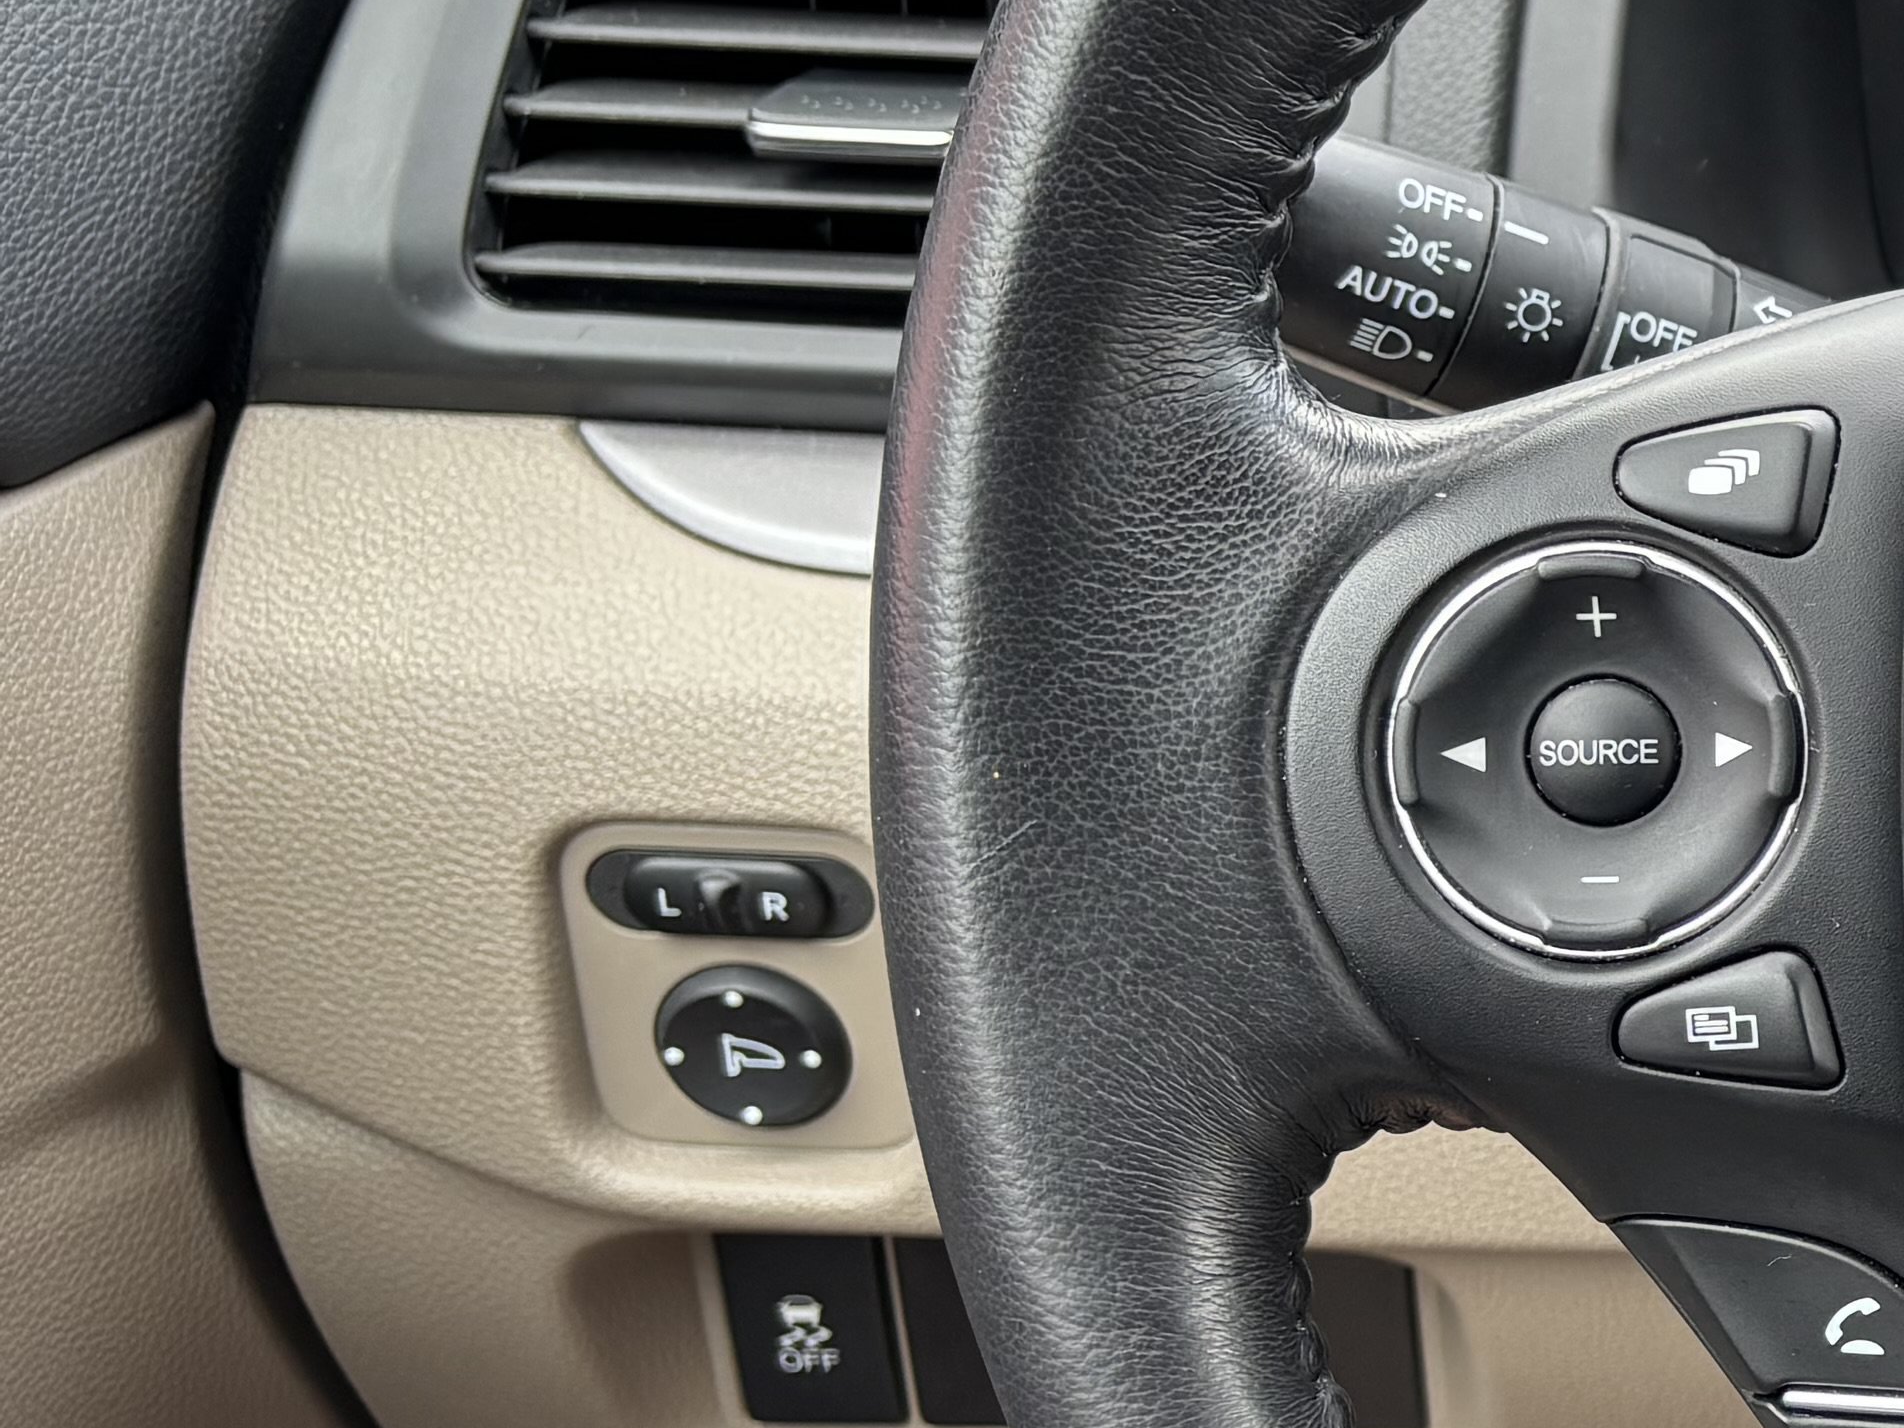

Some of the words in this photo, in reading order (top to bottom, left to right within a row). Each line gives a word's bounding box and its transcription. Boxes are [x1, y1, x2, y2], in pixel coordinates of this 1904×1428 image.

[1398, 178, 1467, 219] OFF
[1336, 264, 1438, 320] AUTO
[1538, 738, 1660, 766] SOURCE
[658, 886, 681, 918] L
[758, 891, 789, 923] R
[779, 1347, 840, 1373] OFF
